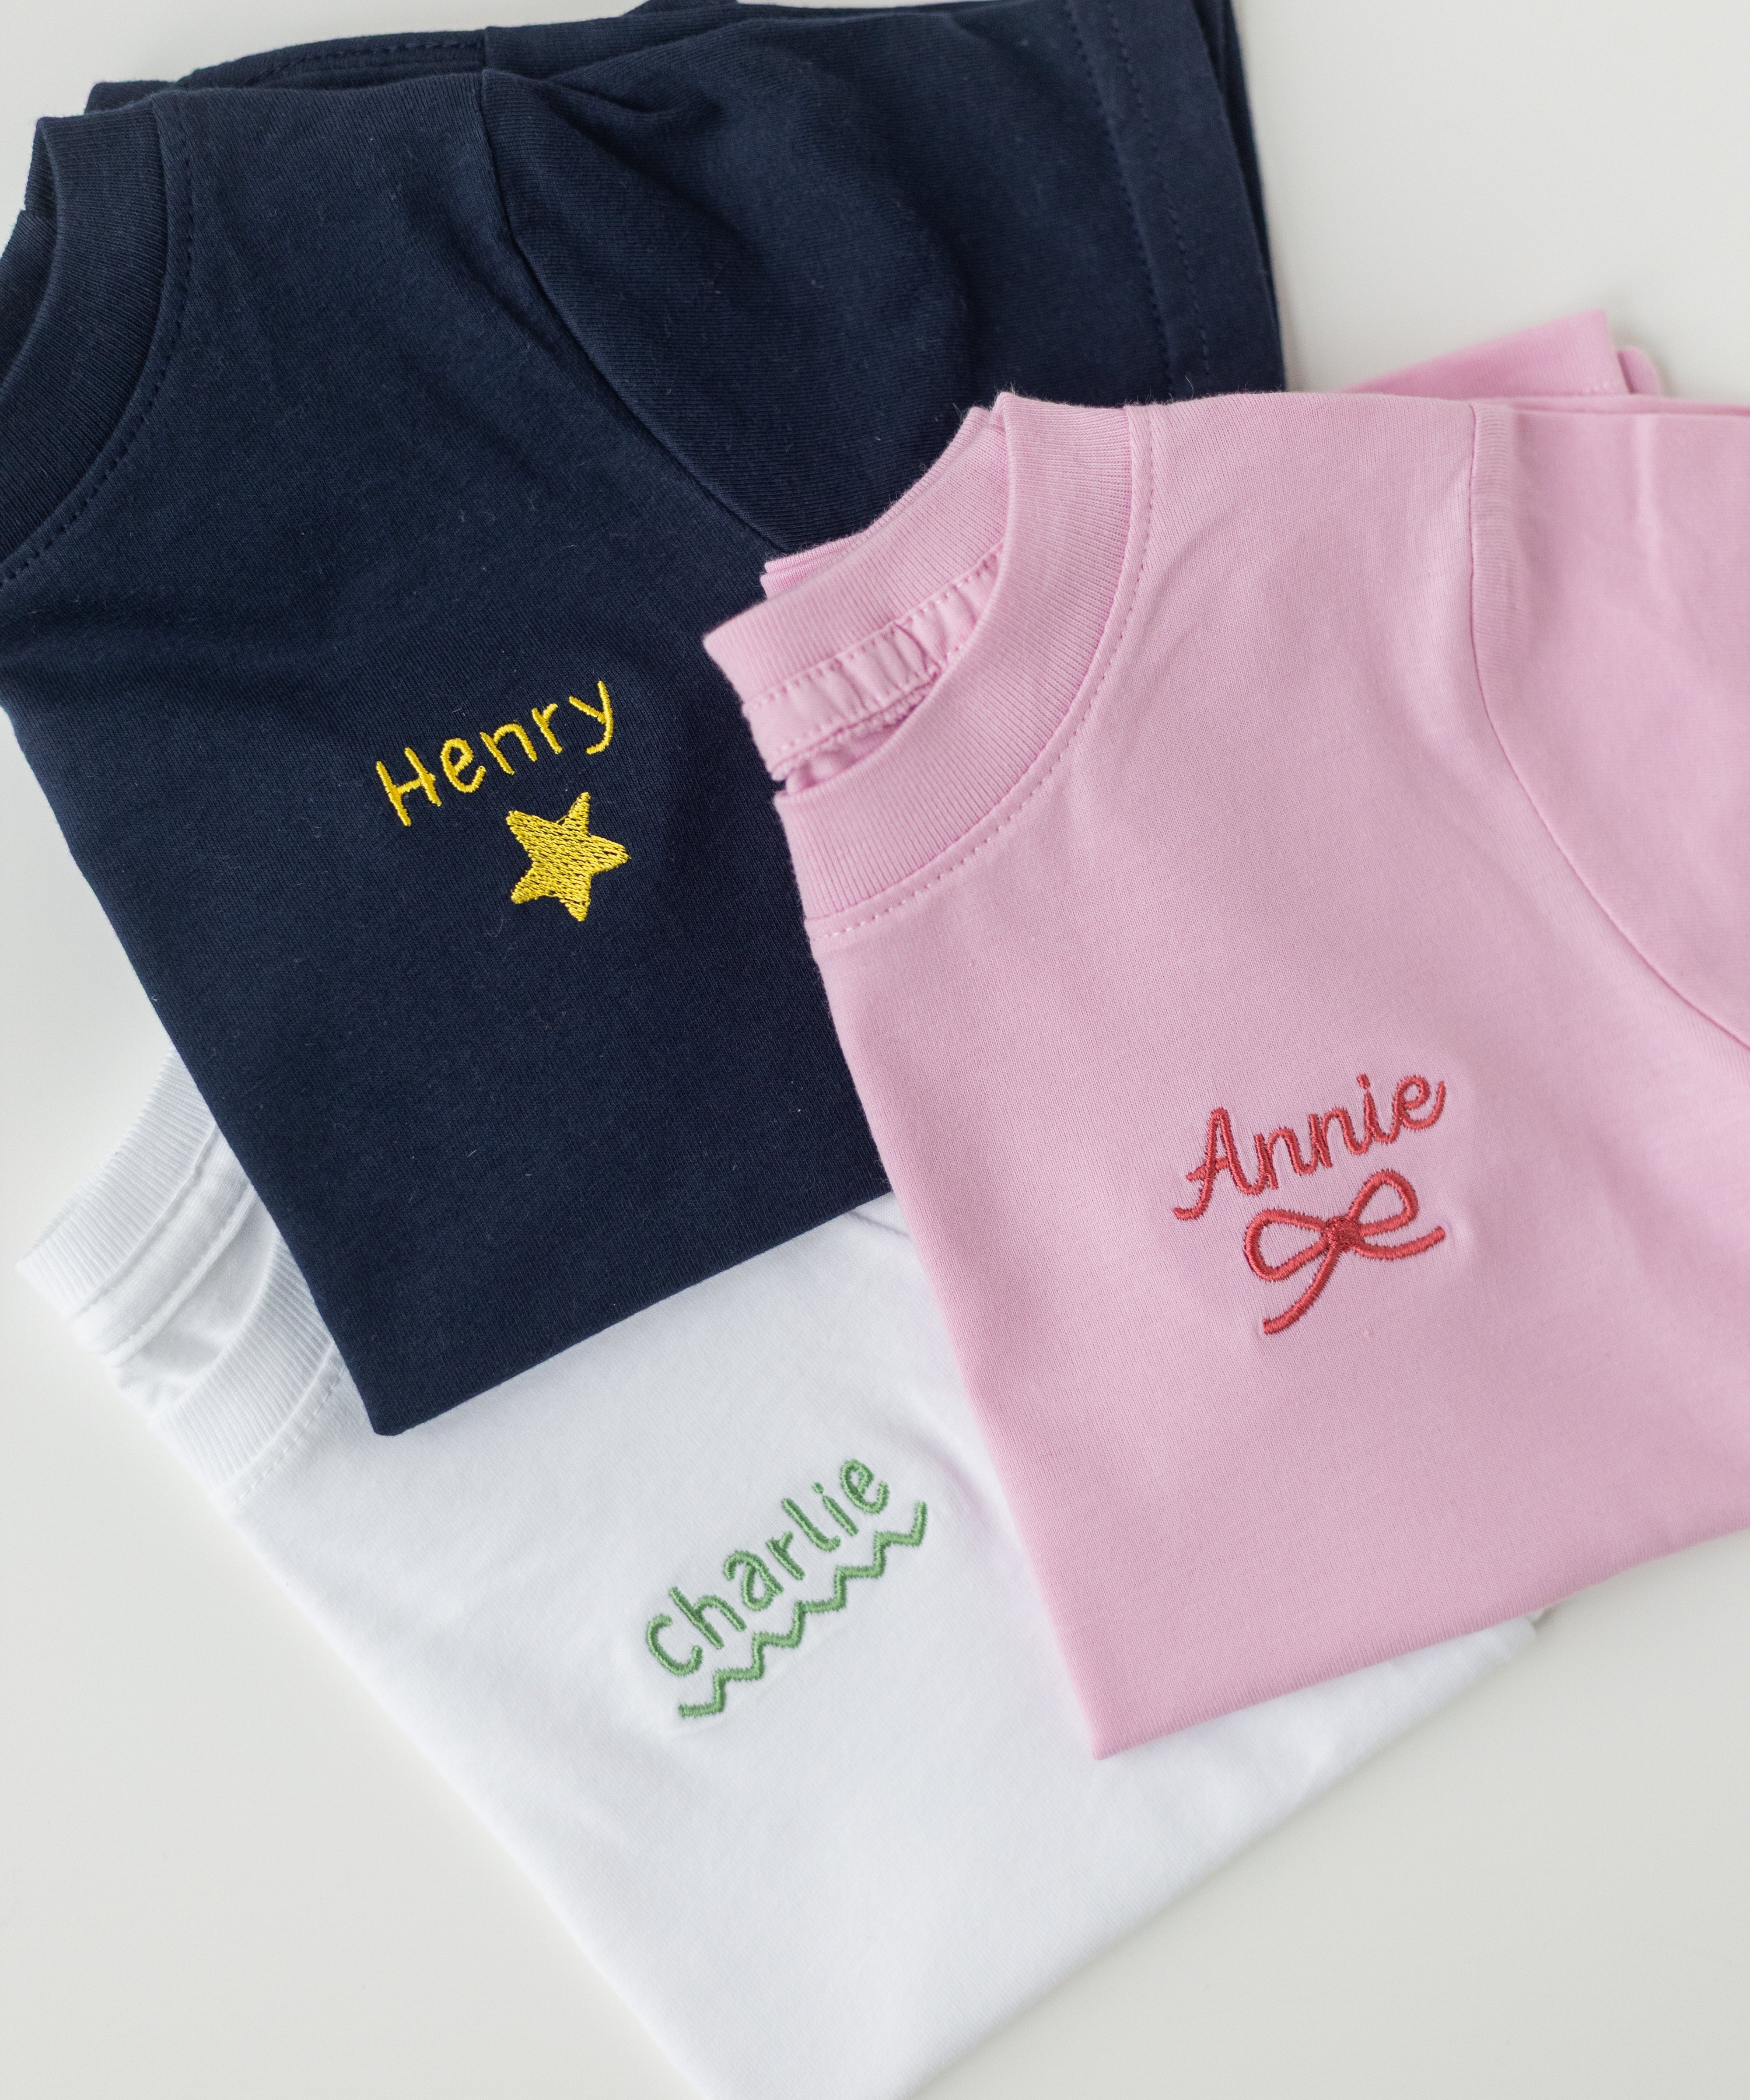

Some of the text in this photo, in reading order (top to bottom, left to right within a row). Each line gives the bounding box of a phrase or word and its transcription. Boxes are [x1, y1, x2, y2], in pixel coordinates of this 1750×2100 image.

[375, 679, 615, 827] Henry
[1173, 1073, 1447, 1221] Annie
[645, 1458, 891, 1677] Charlie
